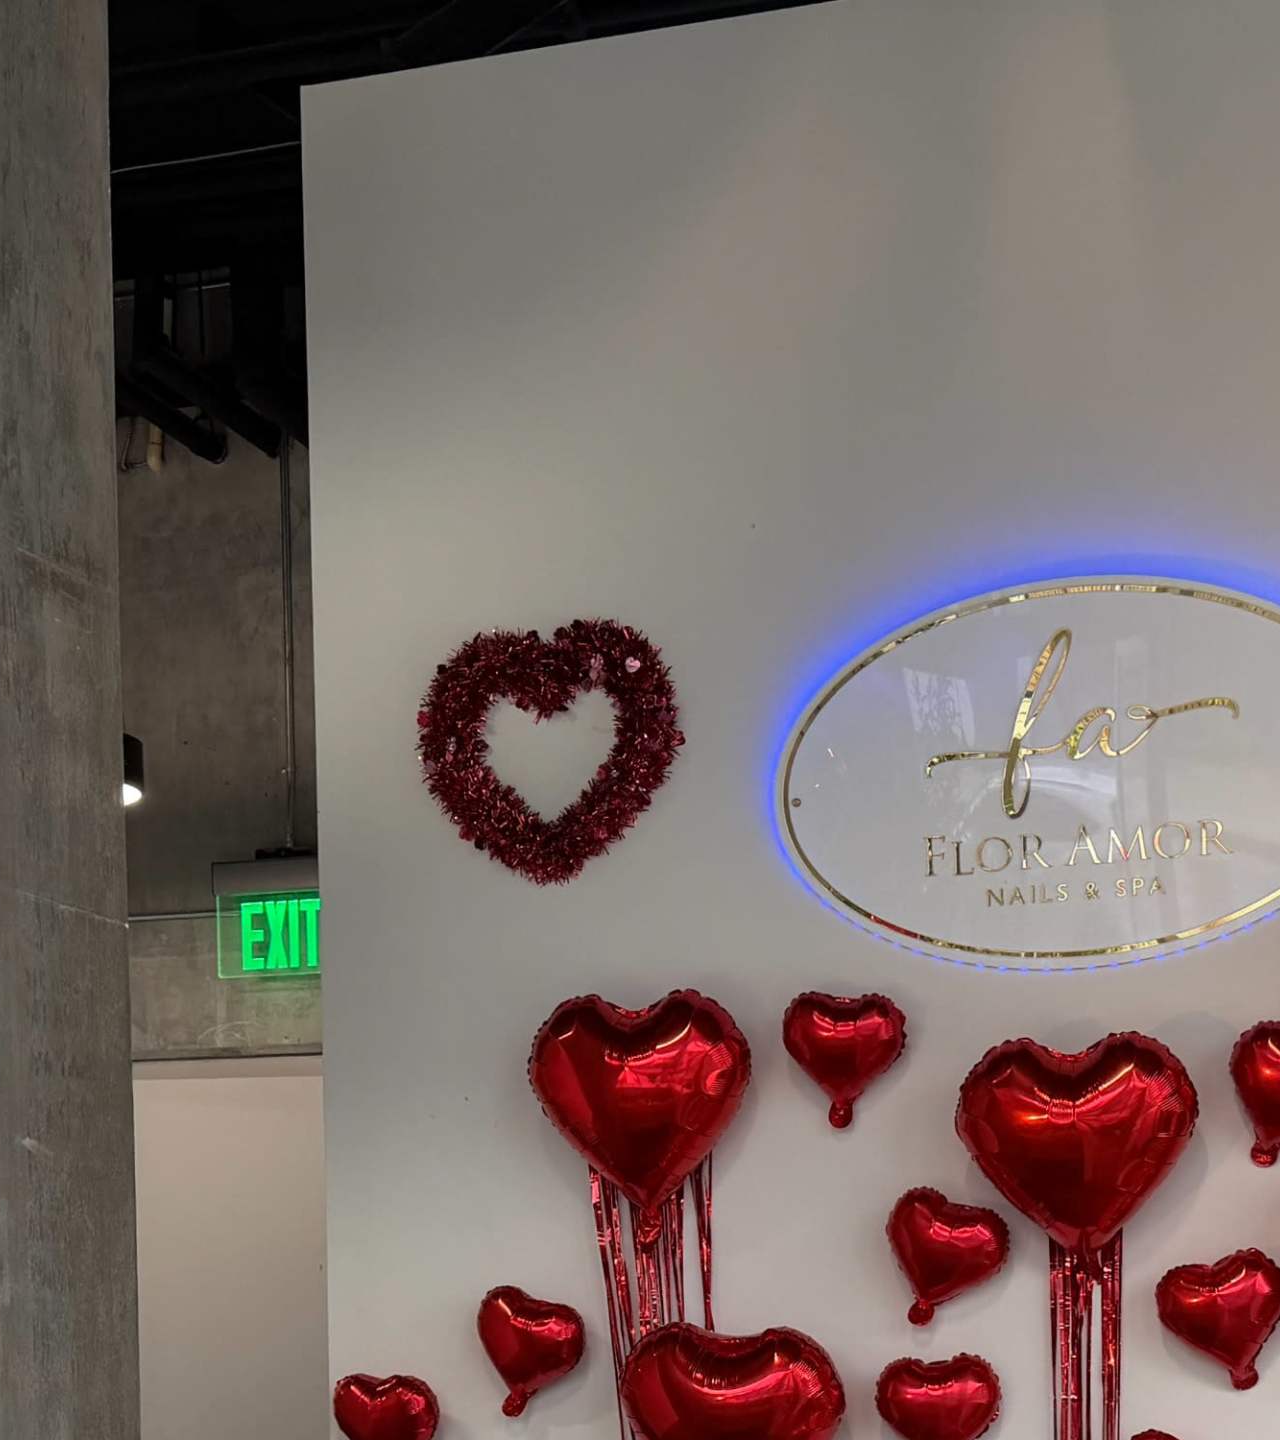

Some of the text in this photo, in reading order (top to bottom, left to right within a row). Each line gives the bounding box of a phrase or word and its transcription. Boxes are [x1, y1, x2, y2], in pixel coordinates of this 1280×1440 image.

[923, 819, 1233, 876] FLOR AMOR
[985, 875, 1166, 907] NAILS & SPA
[240, 898, 320, 971] EXIT
